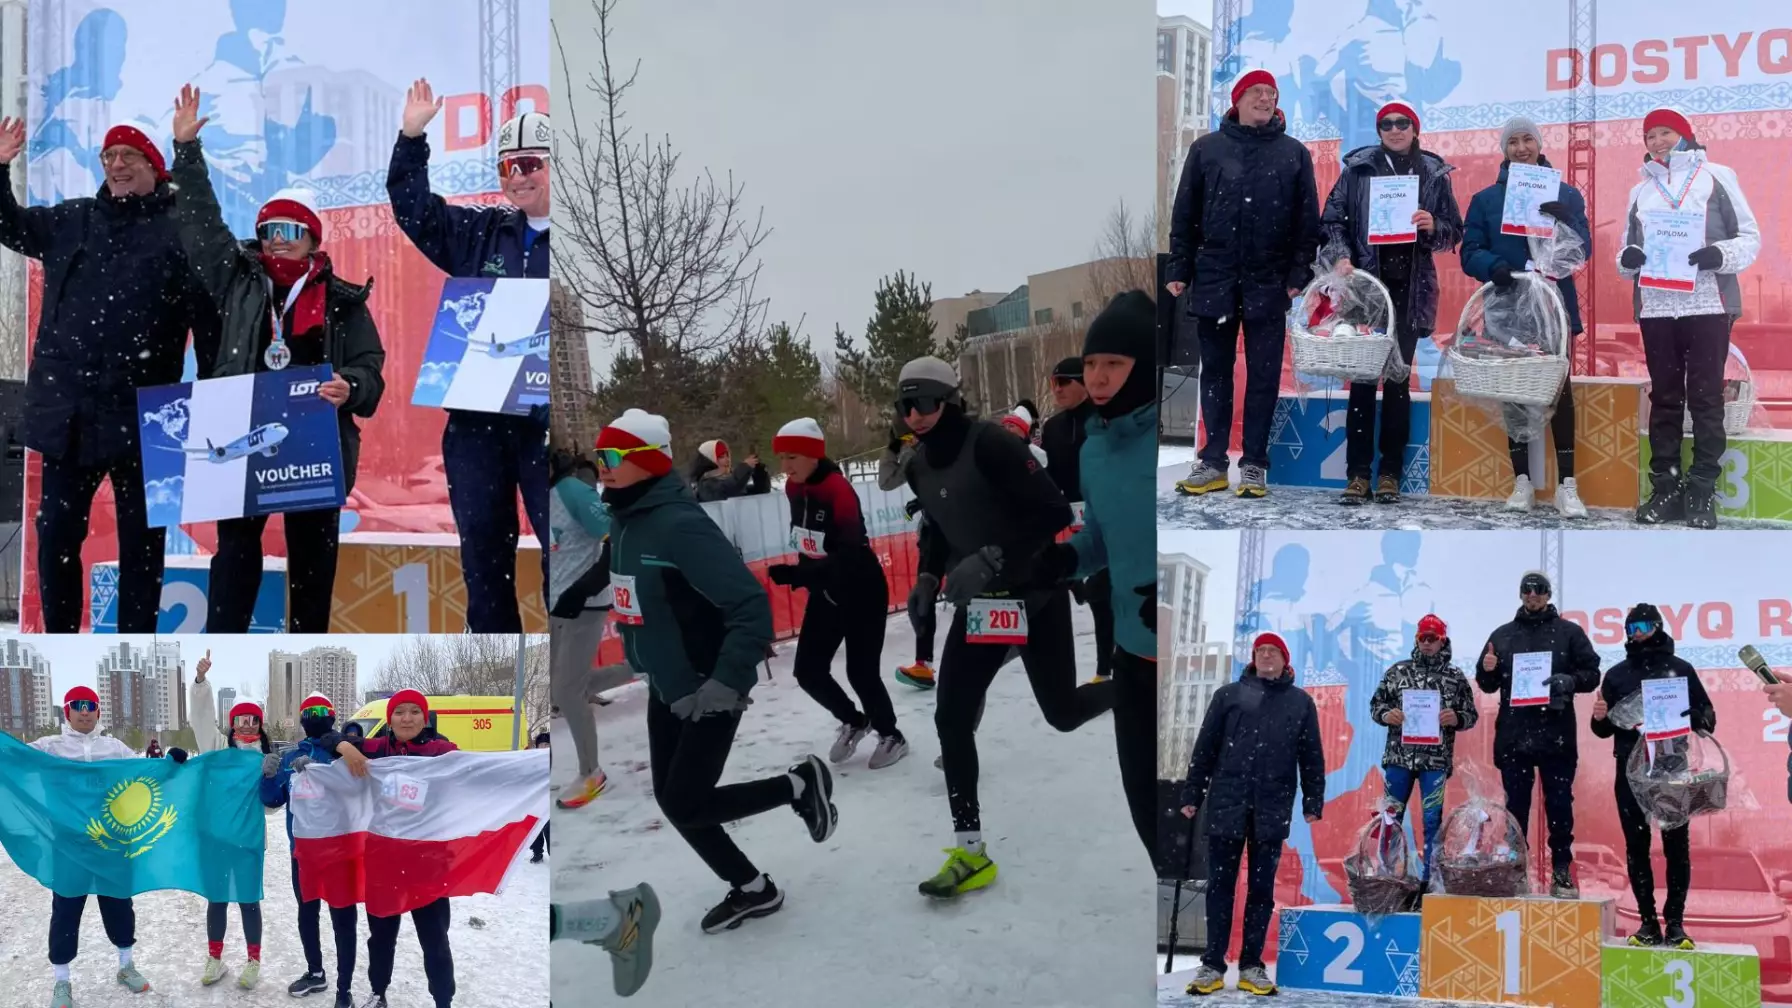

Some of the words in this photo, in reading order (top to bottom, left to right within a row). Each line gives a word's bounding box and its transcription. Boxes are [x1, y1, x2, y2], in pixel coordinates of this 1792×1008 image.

[1657, 230, 1688, 238] DIPLOMA
[525, 371, 550, 385] VO
[289, 381, 320, 397] LOT
[248, 427, 267, 448] LOT
[255, 462, 333, 484] VOUCHER
[1714, 448, 1750, 510] 3
[393, 562, 429, 633] 1
[989, 609, 1018, 629] 207
[473, 718, 492, 730] 305
[1323, 921, 1365, 986] 2
[1496, 910, 1521, 995] 1
[1663, 959, 1695, 1008] 3
